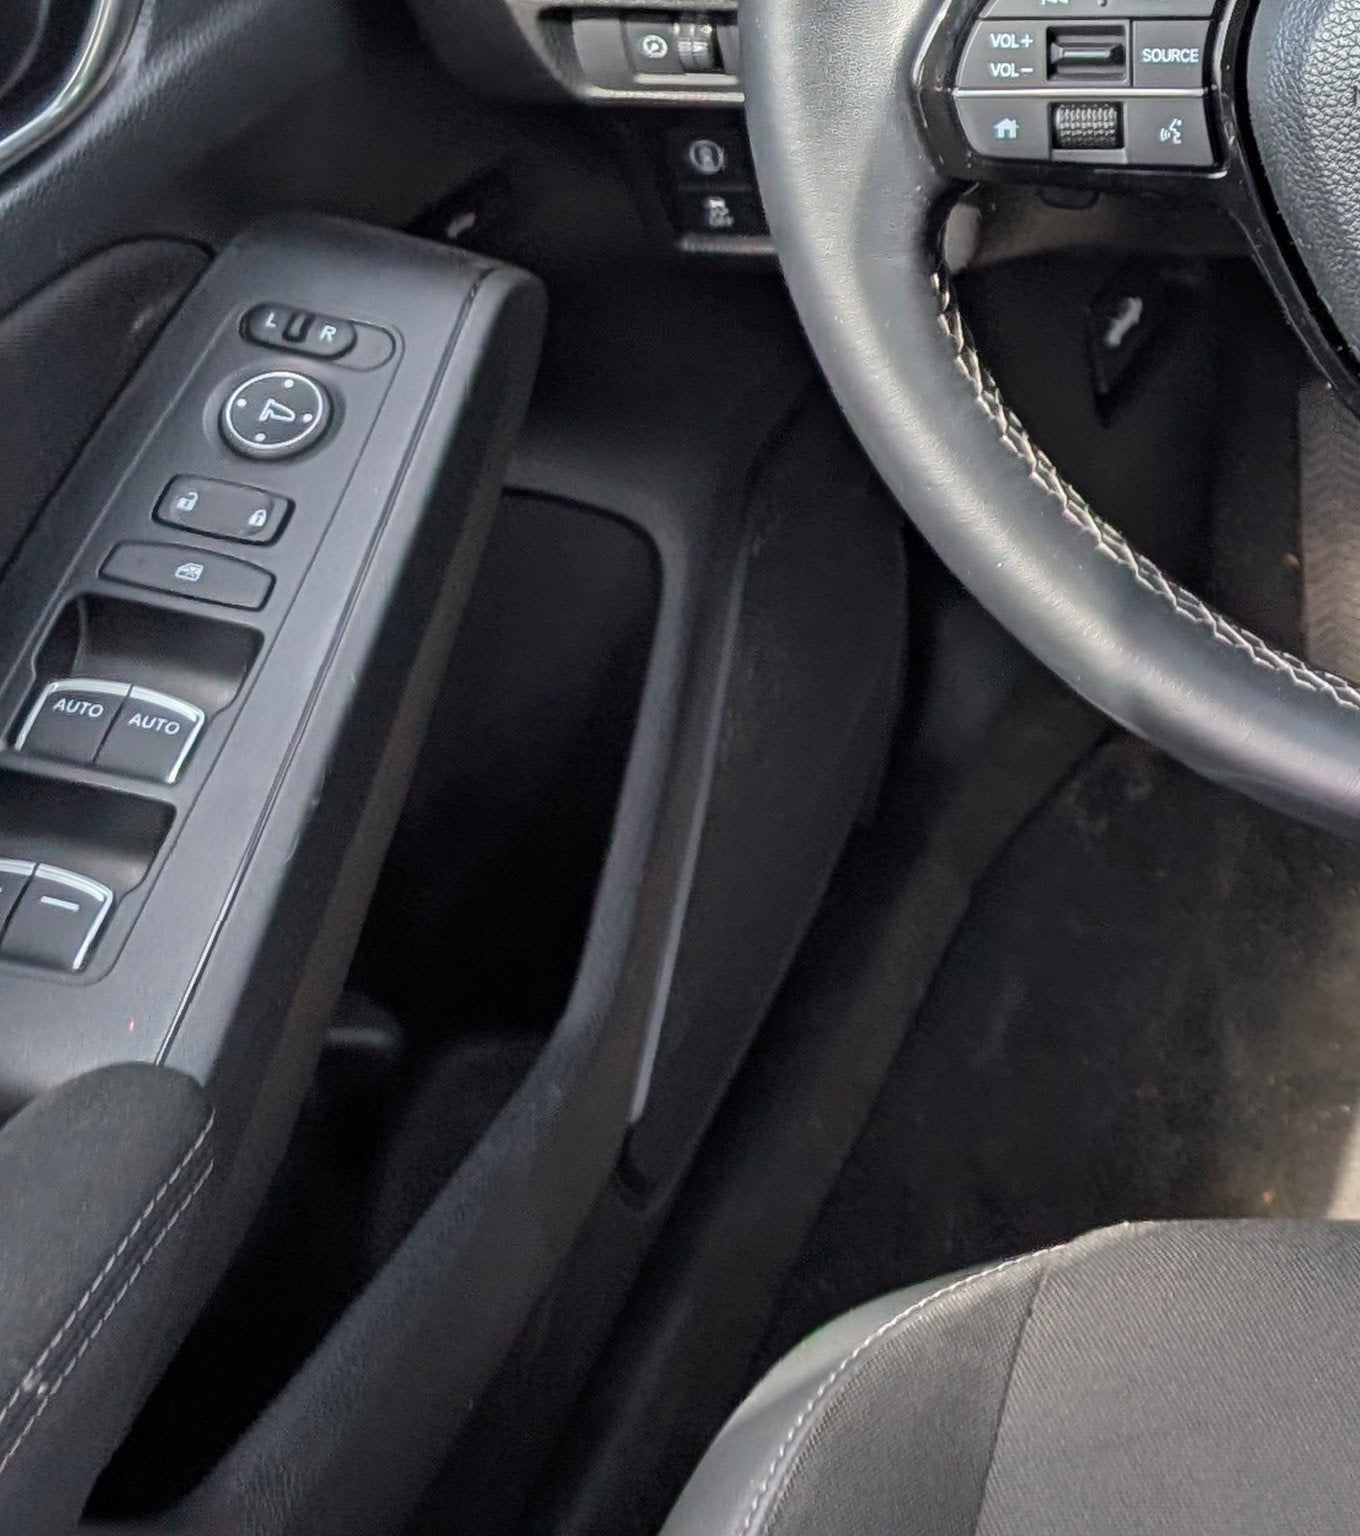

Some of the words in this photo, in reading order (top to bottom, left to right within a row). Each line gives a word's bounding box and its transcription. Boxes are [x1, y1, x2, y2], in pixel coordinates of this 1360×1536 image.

[1141, 47, 1200, 64] SOURCE
[265, 312, 277, 328] L
[320, 324, 338, 341] R
[53, 697, 104, 718] AUTO
[128, 713, 181, 736] AUTO
